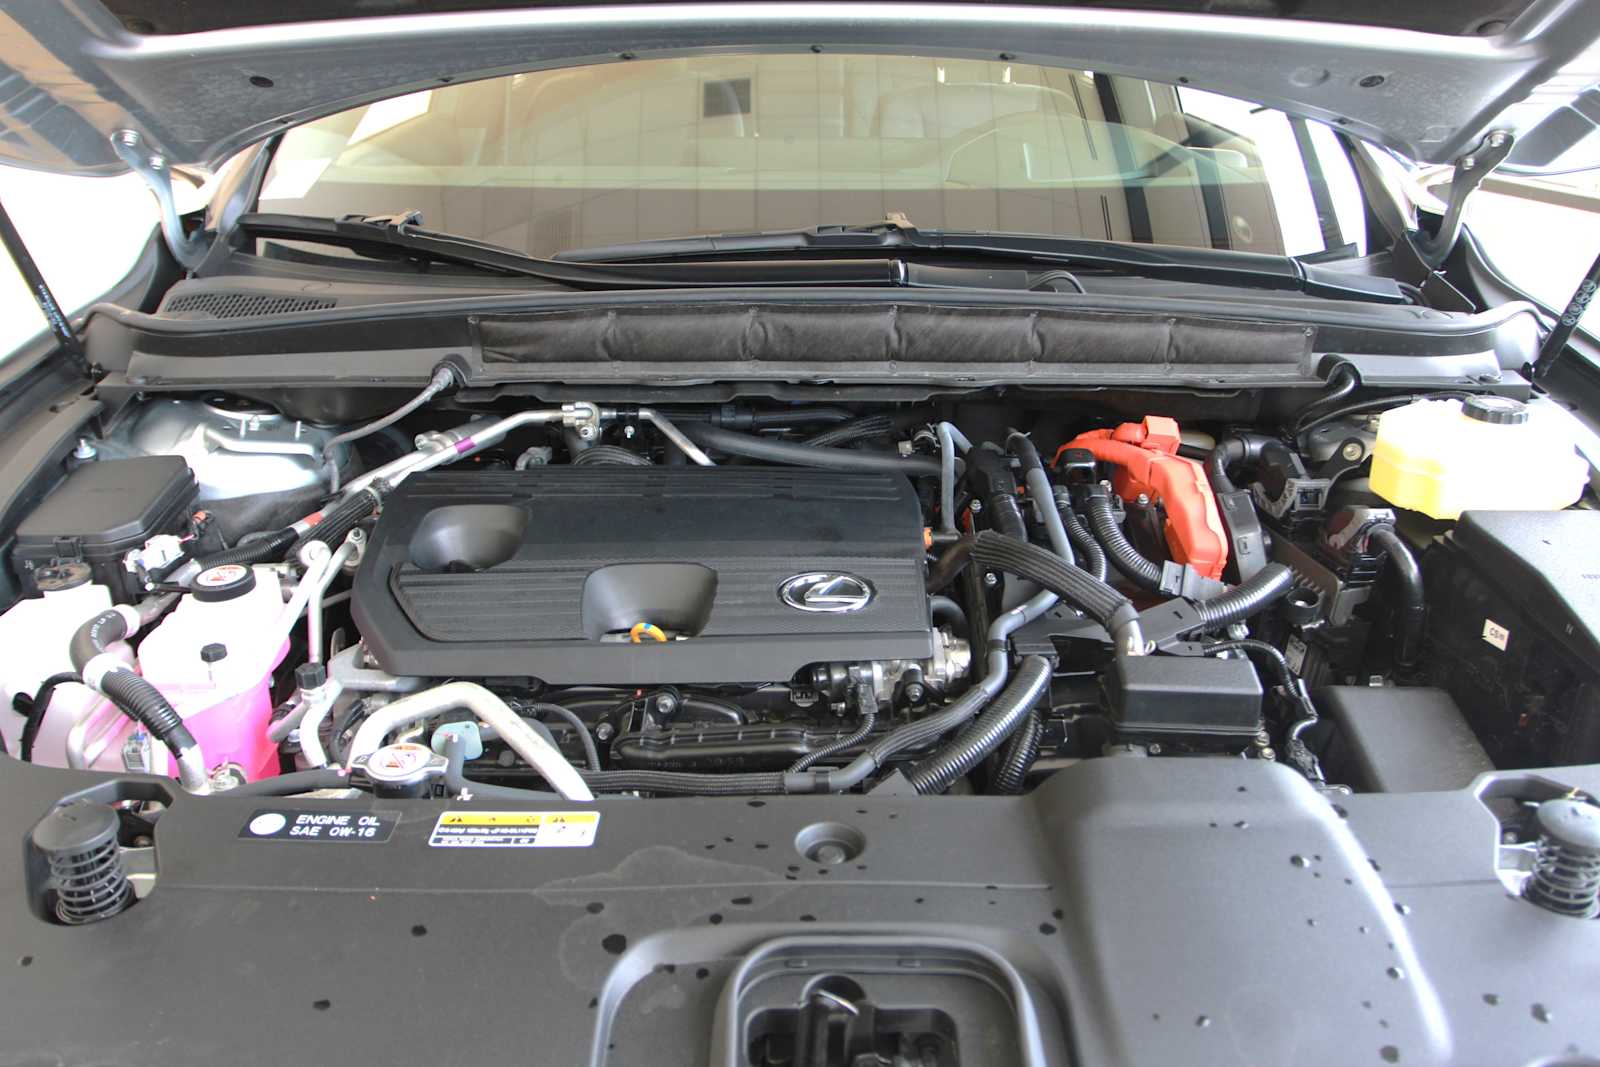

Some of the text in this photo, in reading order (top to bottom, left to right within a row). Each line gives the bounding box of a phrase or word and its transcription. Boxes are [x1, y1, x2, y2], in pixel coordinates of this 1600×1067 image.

[296, 815, 381, 826] ENGINE OIL
[289, 826, 322, 836] SAE
